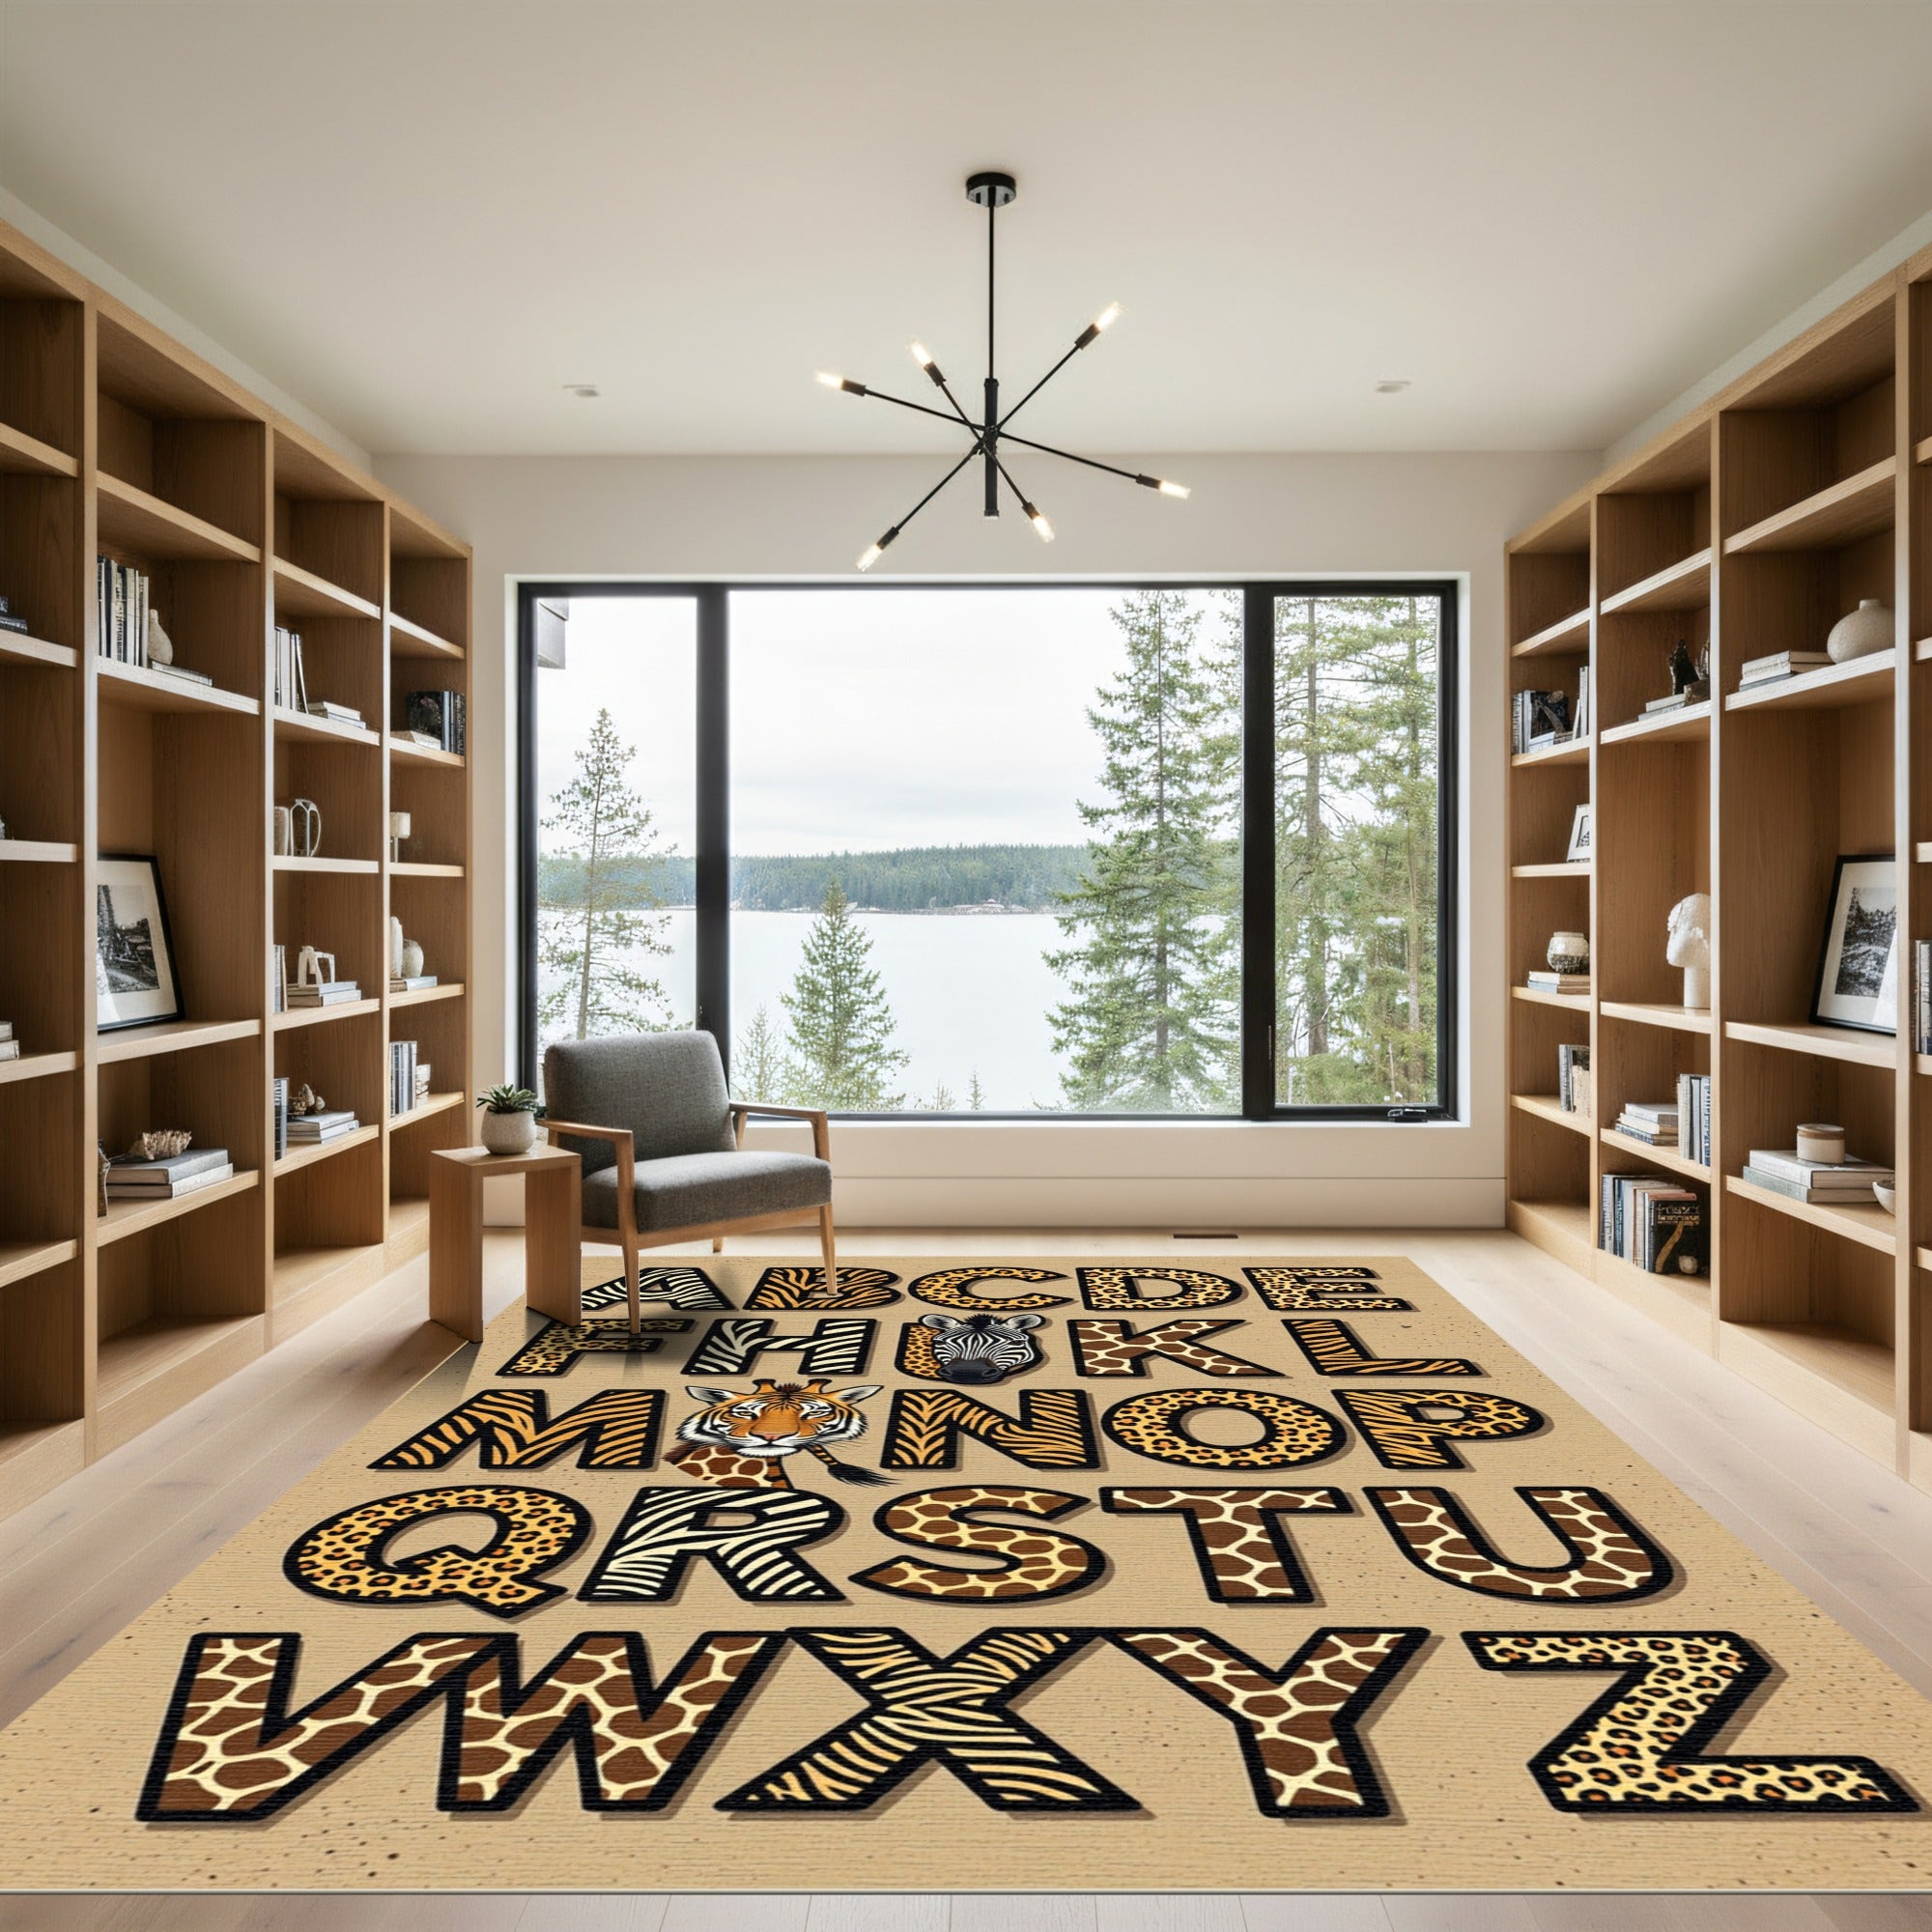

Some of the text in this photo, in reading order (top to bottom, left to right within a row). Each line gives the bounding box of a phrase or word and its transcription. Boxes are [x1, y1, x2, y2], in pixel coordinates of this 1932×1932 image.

[742, 1267, 903, 1310] B
[908, 1267, 1074, 1310] C
[1075, 1267, 1242, 1311] D
[1241, 1267, 1413, 1311] E
[496, 1319, 695, 1376] F
[681, 1319, 879, 1376] H
[1067, 1320, 1286, 1378] K
[1281, 1320, 1484, 1377] L
[367, 1388, 1544, 1470] M N O P
[283, 1485, 1673, 1618] Q R S T U
[713, 1627, 1142, 1811] X
[1092, 1627, 1431, 1818] Y
[1460, 1631, 1921, 1813] Z
